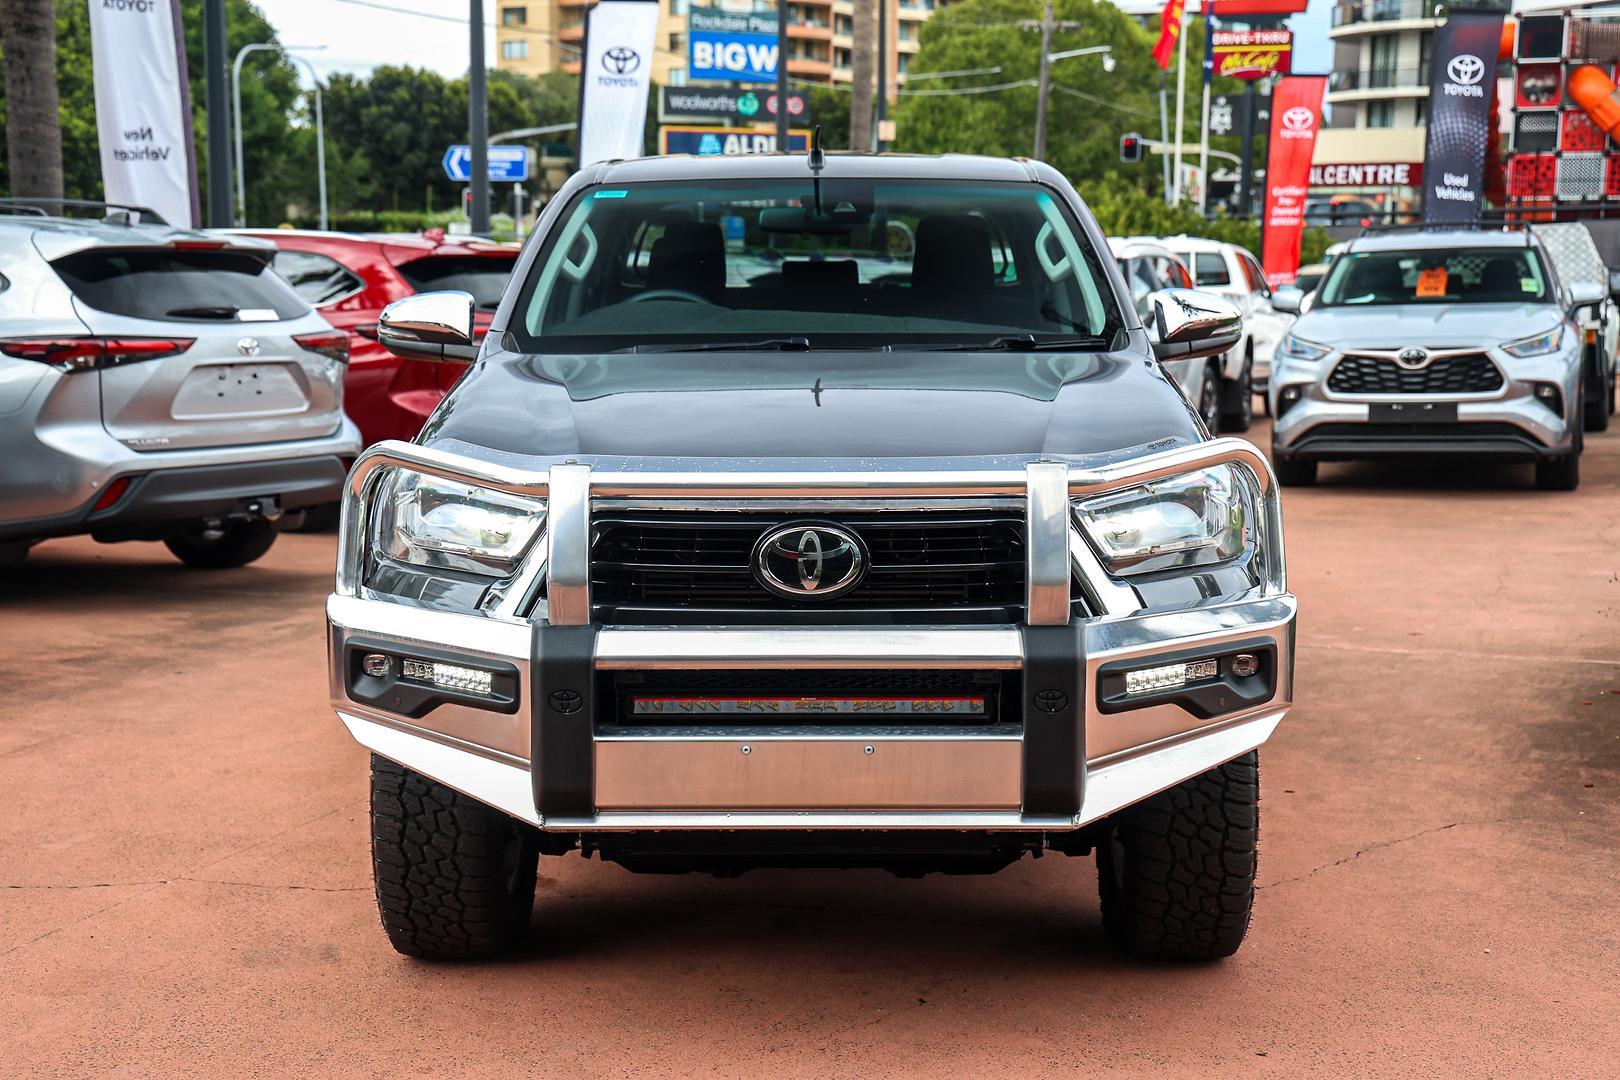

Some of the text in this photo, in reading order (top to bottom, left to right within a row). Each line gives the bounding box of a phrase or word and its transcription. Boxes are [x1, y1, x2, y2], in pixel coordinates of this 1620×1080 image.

[1443, 83, 1483, 97] TOYOTA
[1280, 128, 1313, 139] TOYOTA
[724, 134, 776, 154] ALDI
[1444, 172, 1468, 187] Used
[1435, 186, 1475, 202] Vehicles
